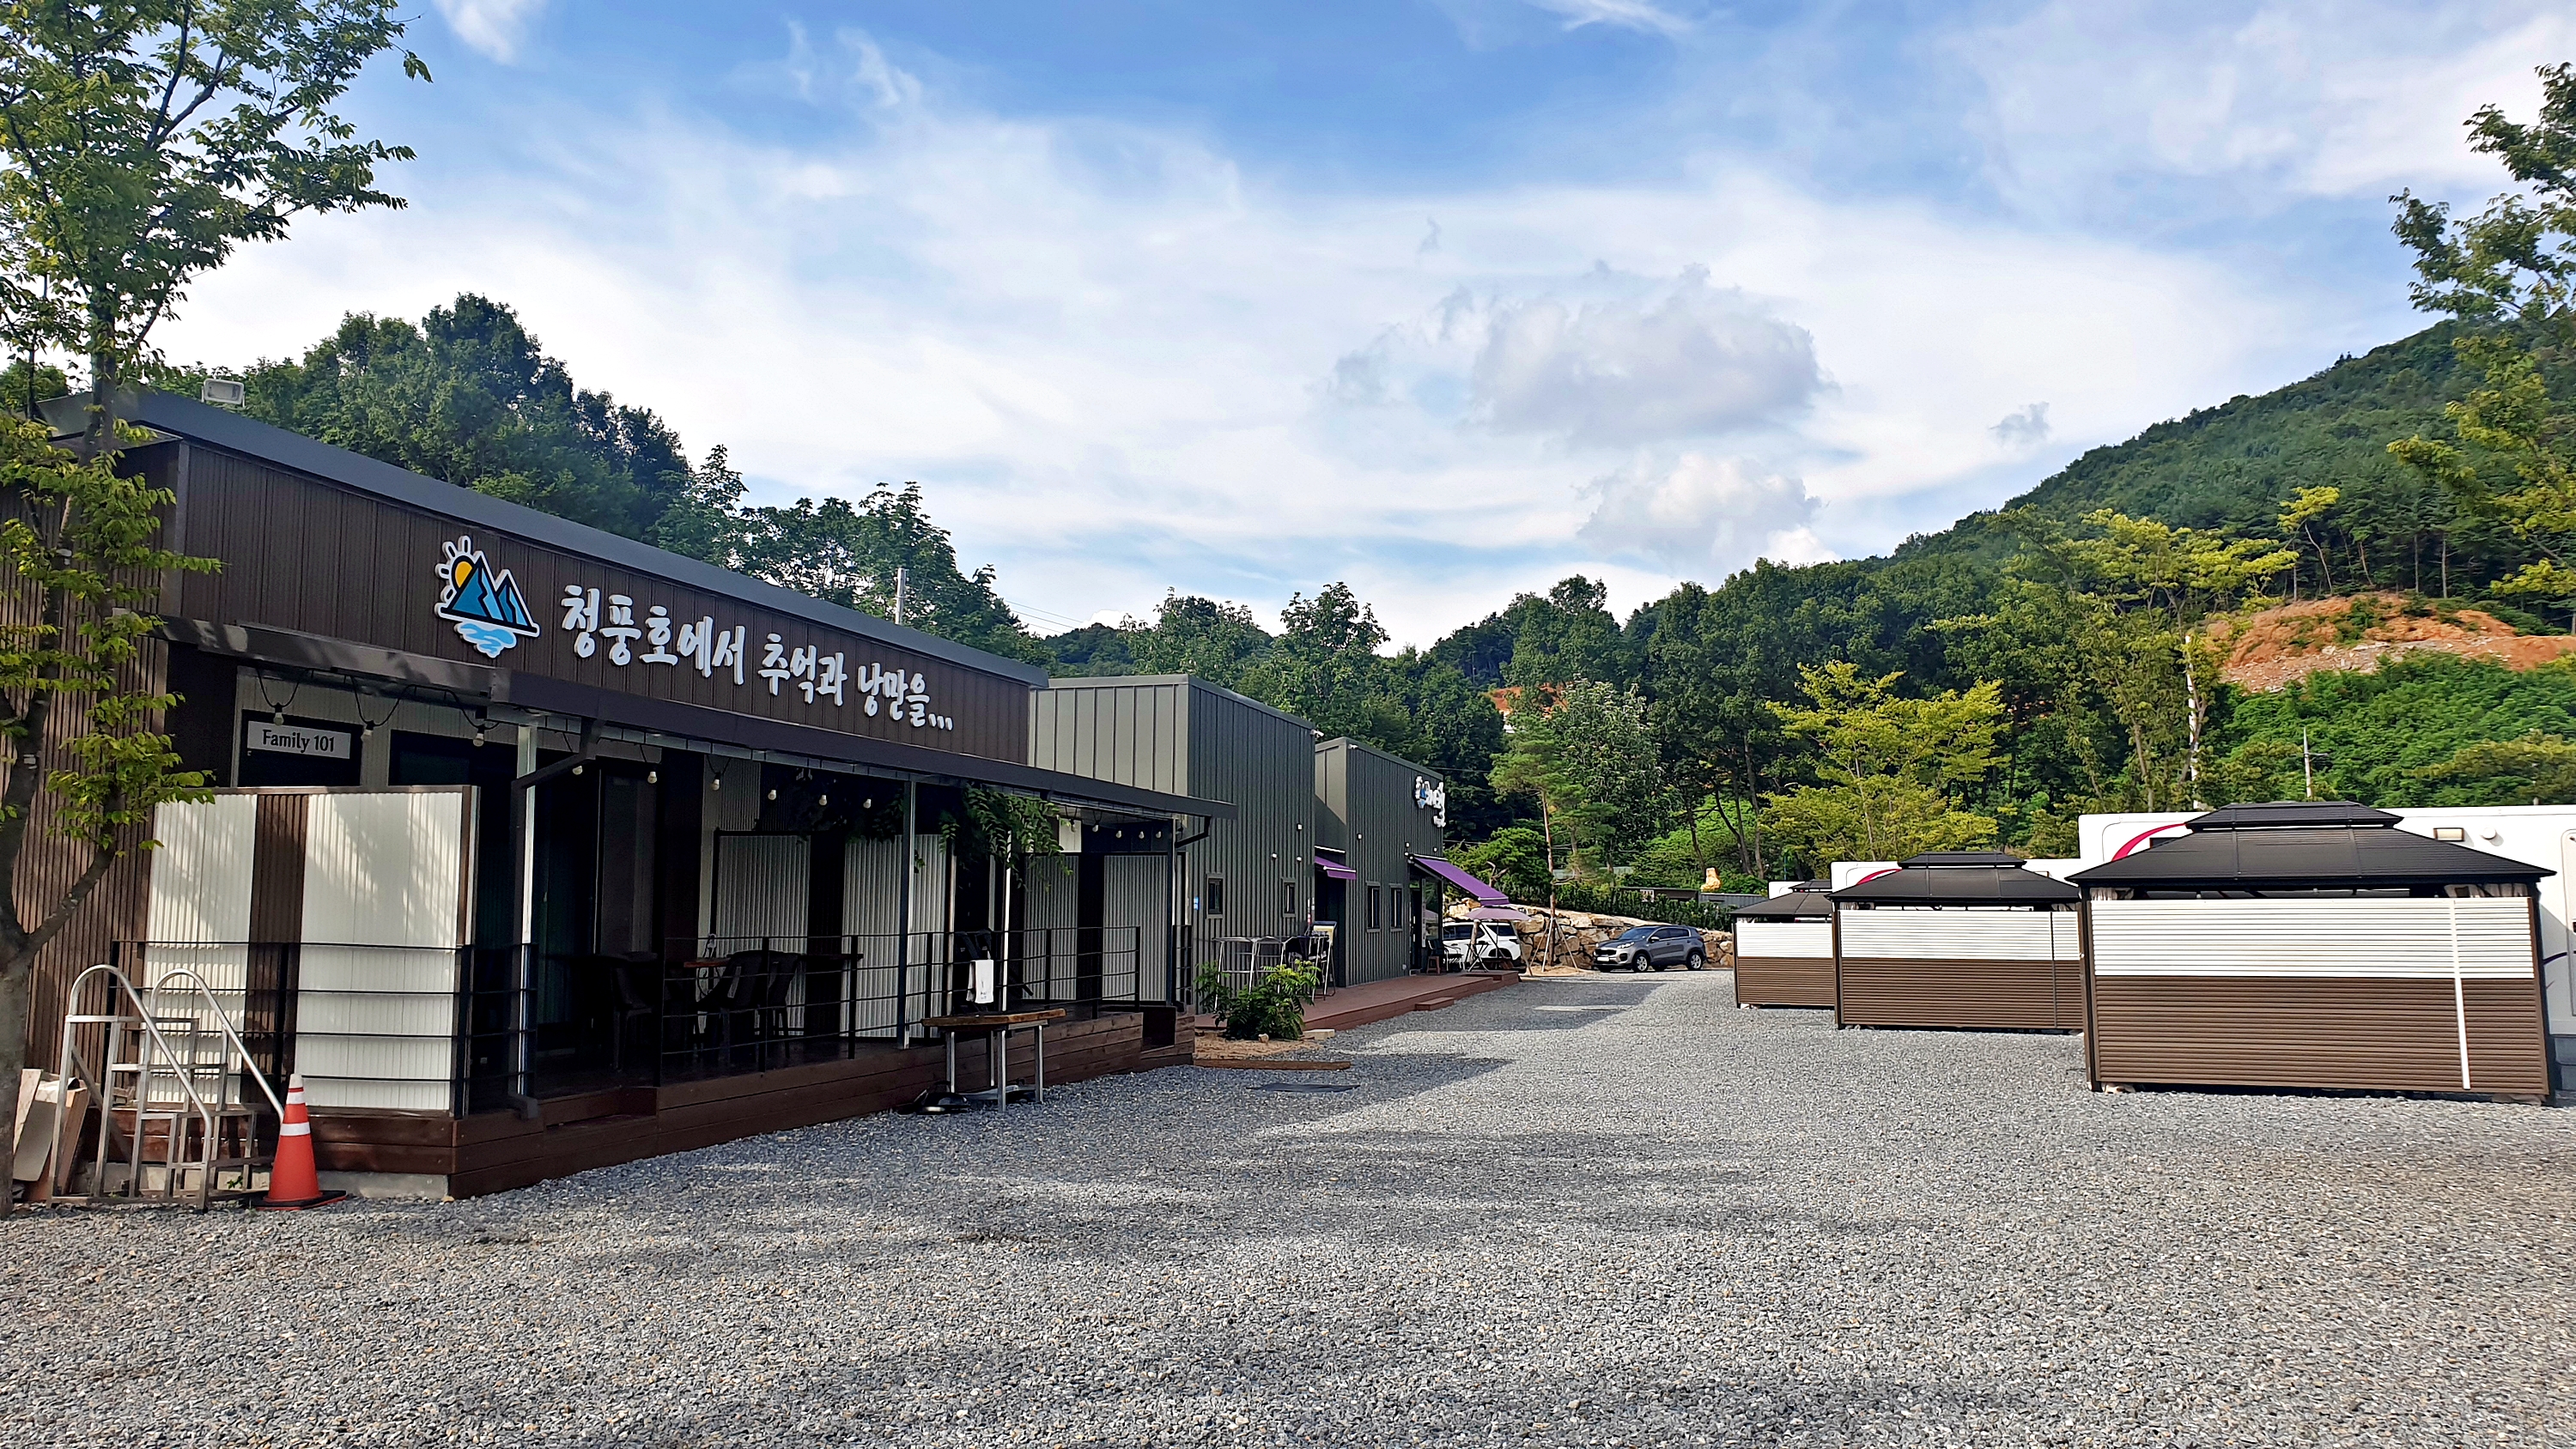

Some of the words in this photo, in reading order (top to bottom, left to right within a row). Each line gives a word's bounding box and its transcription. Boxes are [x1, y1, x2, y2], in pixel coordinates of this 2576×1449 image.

[561, 584, 745, 686] 청풍호에서
[757, 633, 848, 706] 추억과
[262, 729, 310, 754] Family
[313, 735, 334, 752] 101
